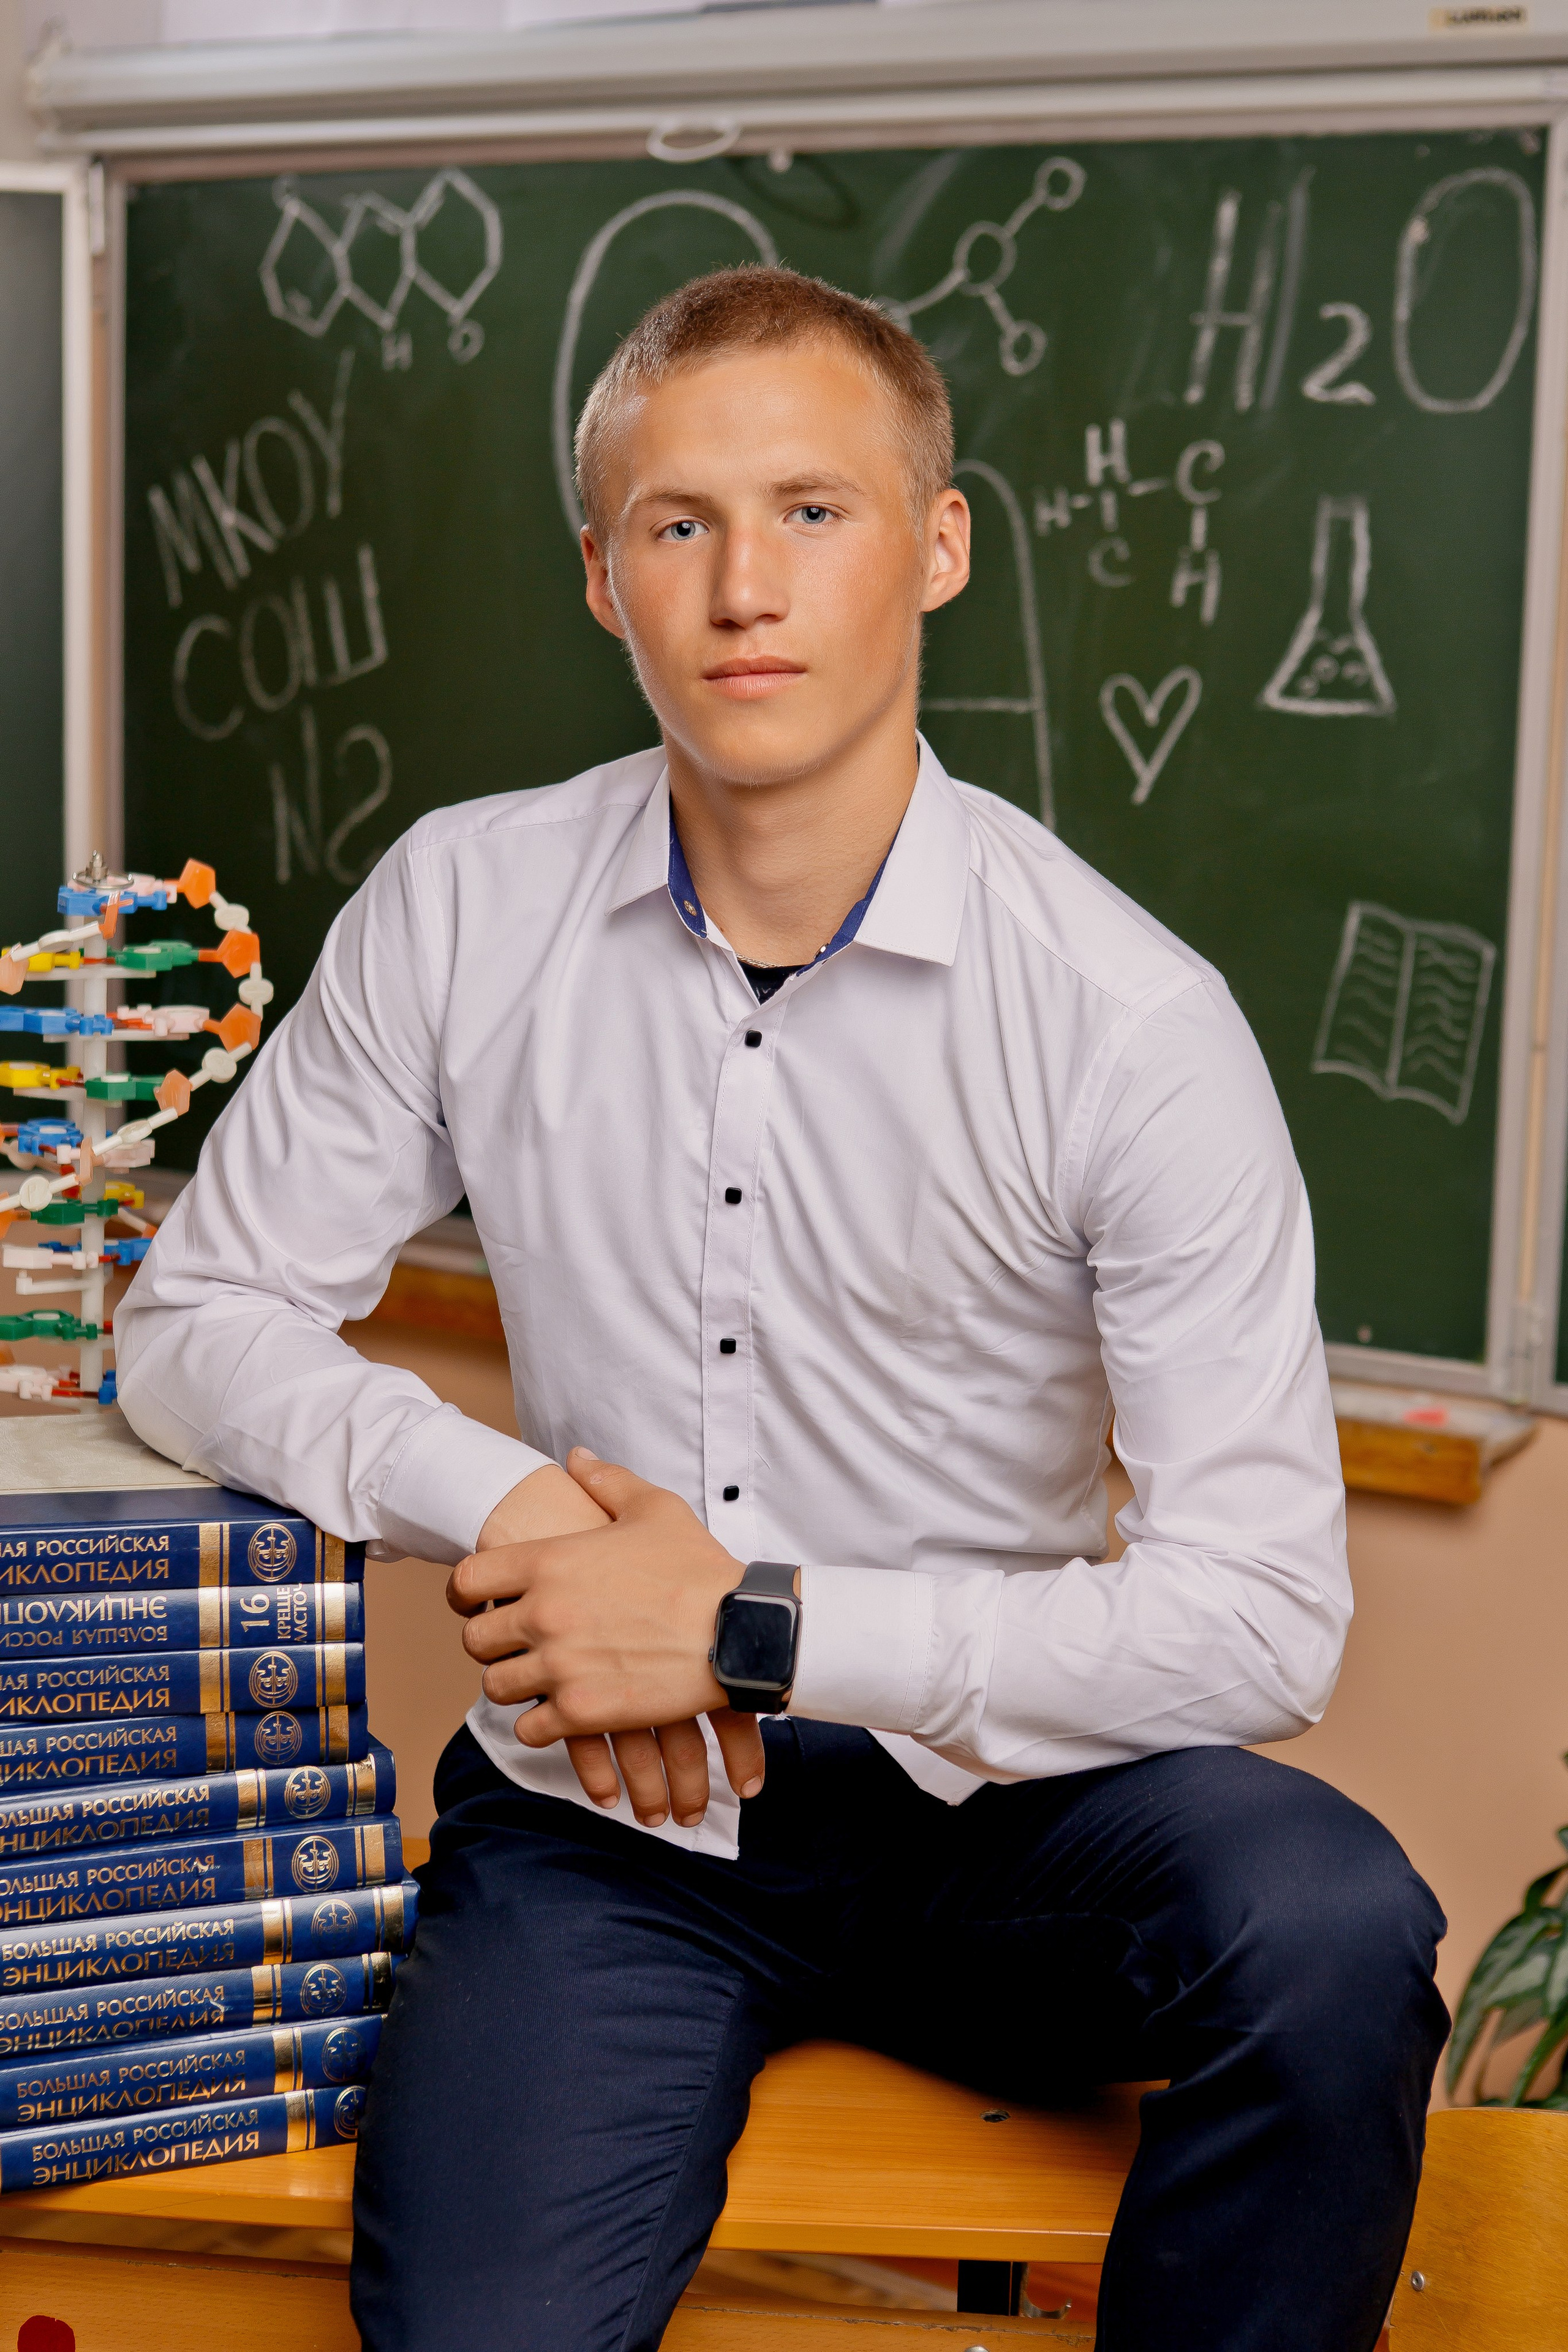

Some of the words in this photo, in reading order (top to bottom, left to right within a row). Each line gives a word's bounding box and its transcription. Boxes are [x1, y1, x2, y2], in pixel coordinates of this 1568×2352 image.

[172, 543, 388, 741] СОШ
[36, 1534, 170, 1557] РОССИЙСКАЯ
[0, 1594, 168, 1625] ЭНЦИКЛОП
[239, 1593, 271, 1633] 16
[72, 1625, 168, 1645] БОЛЬШАЯ
[36, 1665, 170, 1689] РОССИЙСКАЯ
[46, 1726, 177, 1754] РОССИЙСКАЯ
[0, 1749, 177, 1787] ИКЛОПЕДИЯ
[81, 1784, 210, 1818] РОССИЙСКАЯ
[87, 1855, 216, 1886] РОССИЙСКАЯ
[0, 1877, 217, 1922] НЦИКЛОПЕДИЯ
[2, 1934, 97, 1961] БОЛЬШАЯ
[105, 1918, 235, 1950] РОССИЙСКАЯ
[3, 1942, 235, 1987] ЭНЦИКЛОПЕДИЯ
[97, 1985, 225, 2018] РОССИЙСКАЯ
[17, 2069, 111, 2098] БОЛЬШАЯ
[119, 2049, 246, 2084] РОССИЙСКАЯ
[17, 2073, 247, 2122] ЭНЦИКЛОПЕДИЯ
[32, 2131, 125, 2162] БОЛЬШАЯ
[133, 2108, 259, 2145] РОССИЙСКАЯ
[32, 2131, 260, 2185] ЭНЦИКЛОПЕДИЯ
